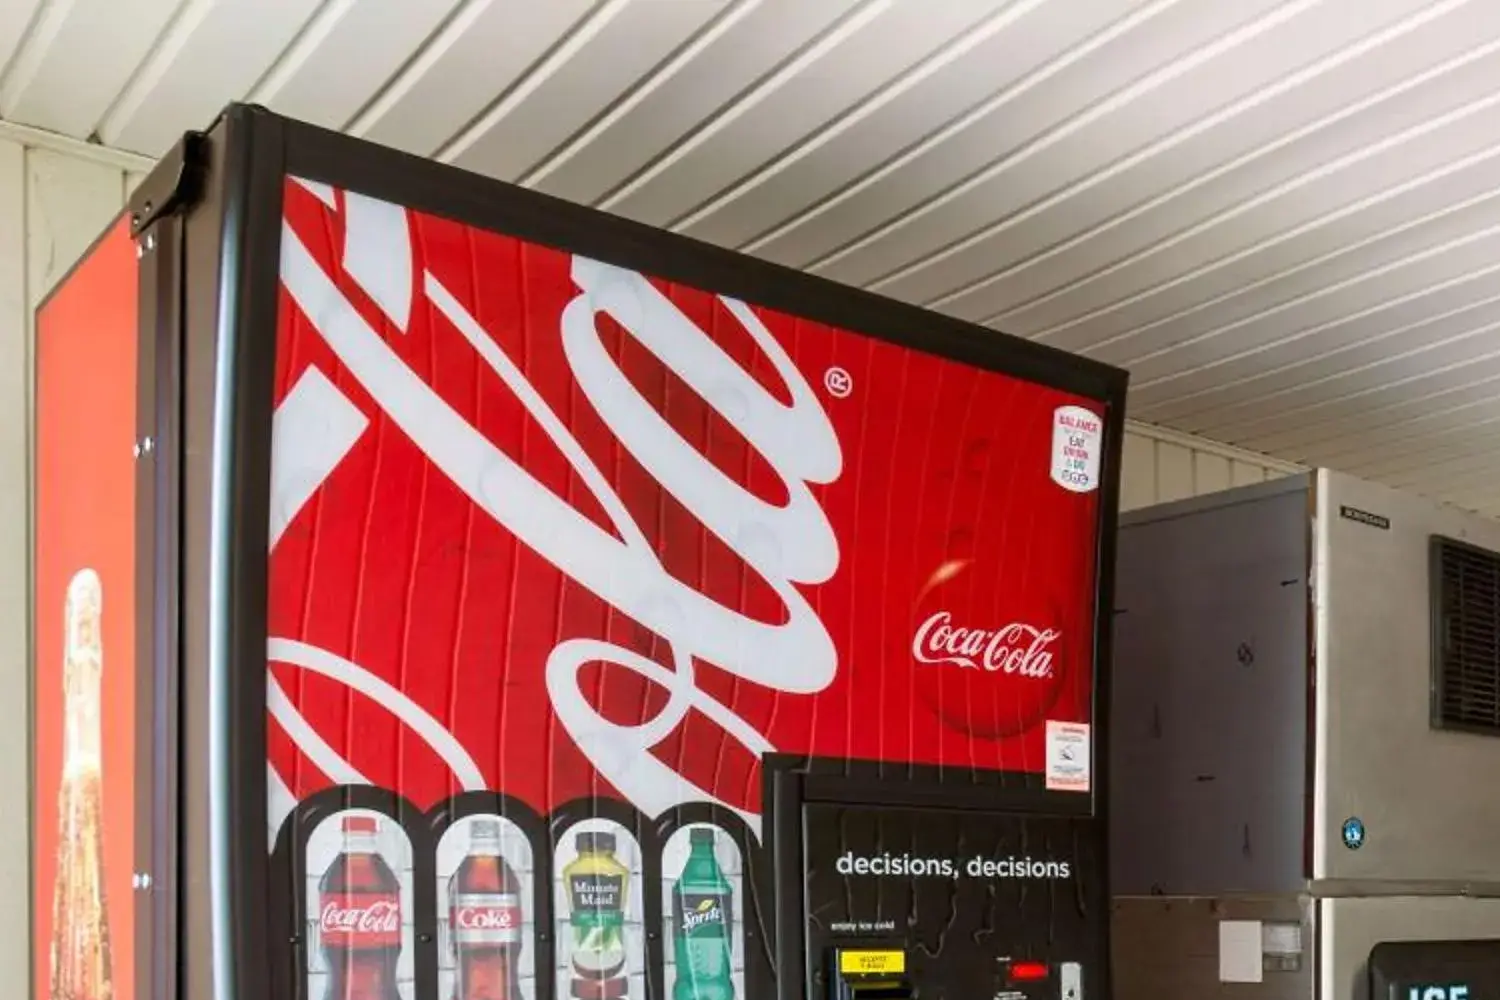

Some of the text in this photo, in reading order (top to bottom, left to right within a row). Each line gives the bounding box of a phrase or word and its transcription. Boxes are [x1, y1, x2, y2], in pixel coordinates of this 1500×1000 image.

[912, 610, 1063, 679] Coca-Cola
[835, 851, 1071, 880] decisions, decisions
[457, 907, 512, 929] Coke
